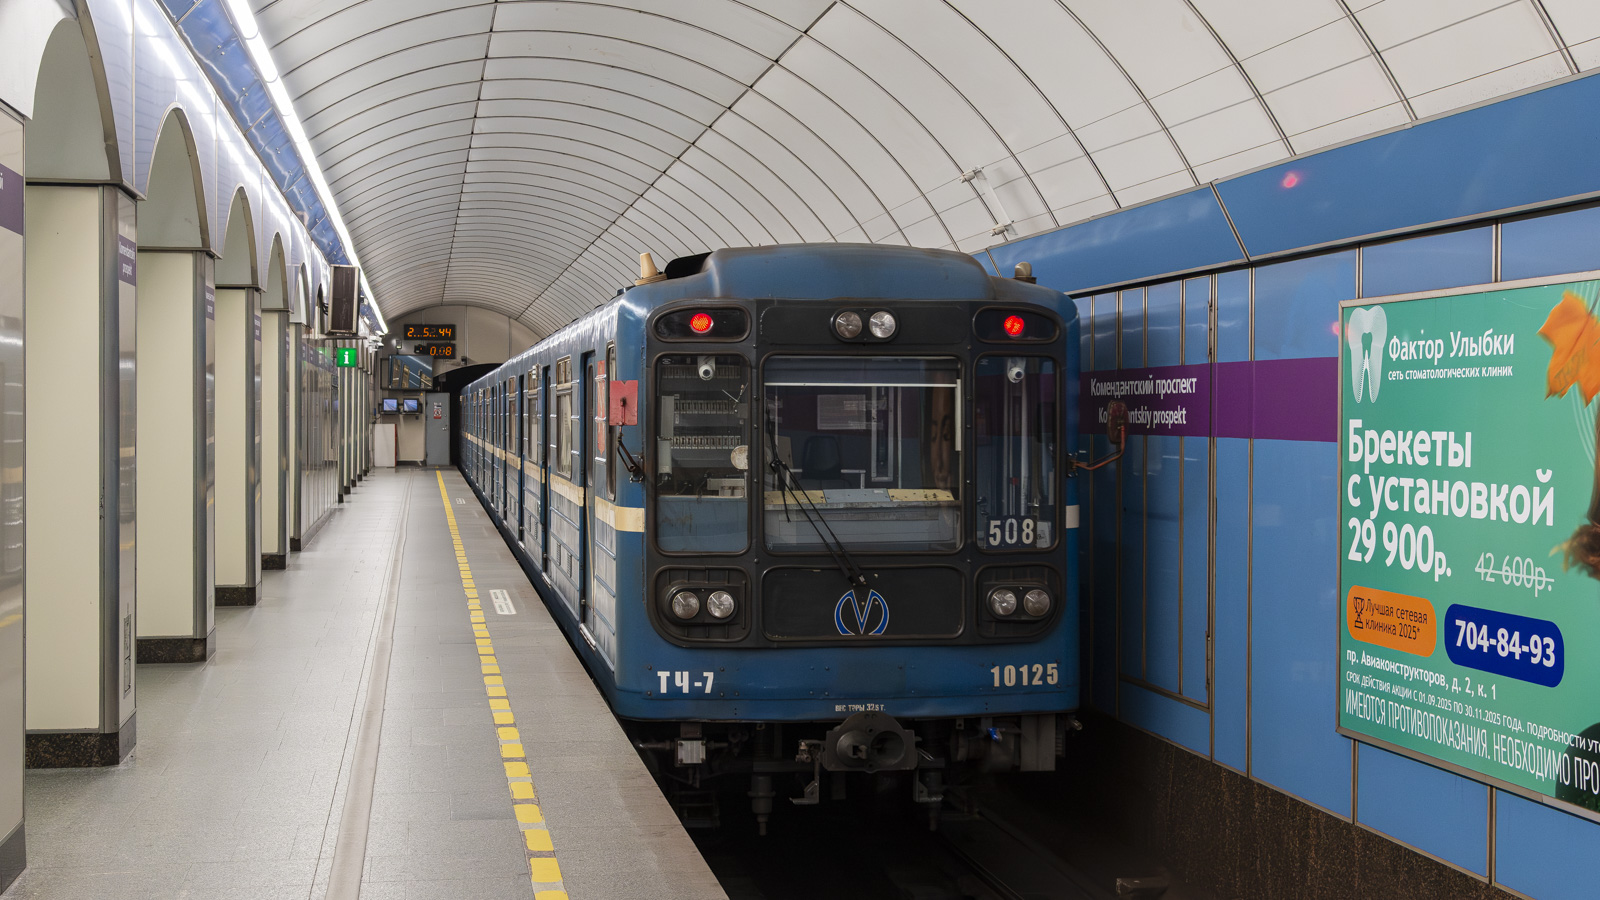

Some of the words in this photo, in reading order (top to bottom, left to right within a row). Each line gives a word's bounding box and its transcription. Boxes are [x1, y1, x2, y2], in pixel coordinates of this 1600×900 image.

[1388, 336, 1444, 365] Фактор
[1450, 328, 1515, 358] Улыбки
[1090, 374, 1154, 399] Комендантский
[1155, 377, 1197, 399] проспект
[1388, 369, 1404, 381] сеть
[1405, 366, 1480, 379] стоматологических
[1481, 365, 1513, 377] клиник
[1153, 405, 1187, 429] prospekt
[1348, 418, 1472, 474] Брекеты
[1347, 474, 1361, 507] с
[1368, 468, 1555, 527] установкой
[988, 518, 1034, 546] 508
[1347, 517, 1376, 564] 29
[1382, 521, 1451, 582] 900р.
[1474, 552, 1496, 582] 42
[1365, 598, 1394, 617] Лучшая
[1396, 608, 1428, 624] сетевая
[1365, 619, 1397, 635] клиника
[1455, 619, 1556, 668] 704-84-93
[657, 671, 714, 694] ТЧ-7
[990, 663, 1058, 687] 10125
[1346, 649, 1359, 666] пр.
[1360, 650, 1449, 690] Авиаконструкторов,
[1451, 677, 1462, 694] д.
[1465, 676, 1474, 697] 2,
[1477, 683, 1487, 698] к.
[1491, 683, 1496, 700] 1
[1346, 670, 1361, 685] СРОК
[1361, 674, 1391, 693] ДЕЙСТВИЯ
[1391, 684, 1412, 700] АКЦИИ
[1413, 690, 1418, 702] С
[1418, 691, 1452, 711] 01.09.2025
[1453, 701, 1464, 715] ПО
[1464, 704, 1501, 725] 30.11.2025
[1502, 714, 1525, 733] ГОДА.
[1527, 721, 1586, 750] ПОДРОБНОСТИ
[1587, 738, 1600, 754] УТ
[1345, 688, 1386, 726] ИМЕЮТСЯ
[1388, 700, 1491, 760] ПРОТИВОПОКАЗАНИЯ.
[1493, 732, 1571, 786] НЕОБХОДИМО
[1574, 756, 1600, 795] ПРО
